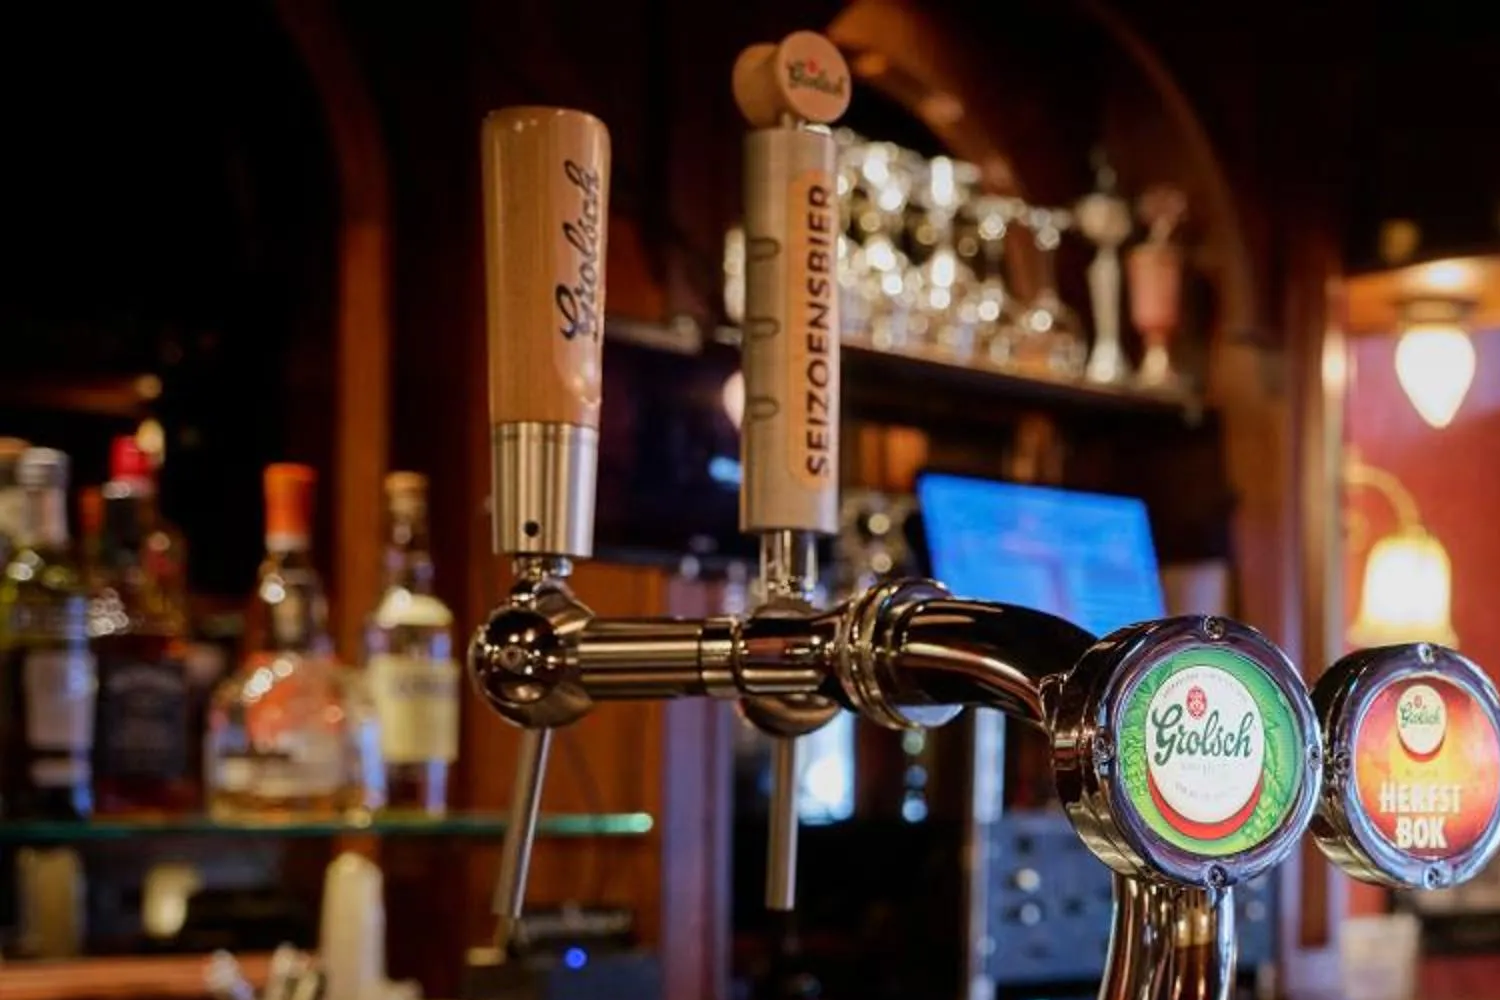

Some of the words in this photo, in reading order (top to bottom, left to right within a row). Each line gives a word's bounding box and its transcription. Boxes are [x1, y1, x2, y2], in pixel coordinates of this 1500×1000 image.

[555, 159, 599, 343] Grolsch
[806, 184, 831, 478] SEIZOENSBIER
[1151, 703, 1255, 766] Grolsch
[1399, 701, 1442, 729] Grolsch
[1379, 780, 1463, 814] HERFST
[1395, 815, 1448, 849] BOK
